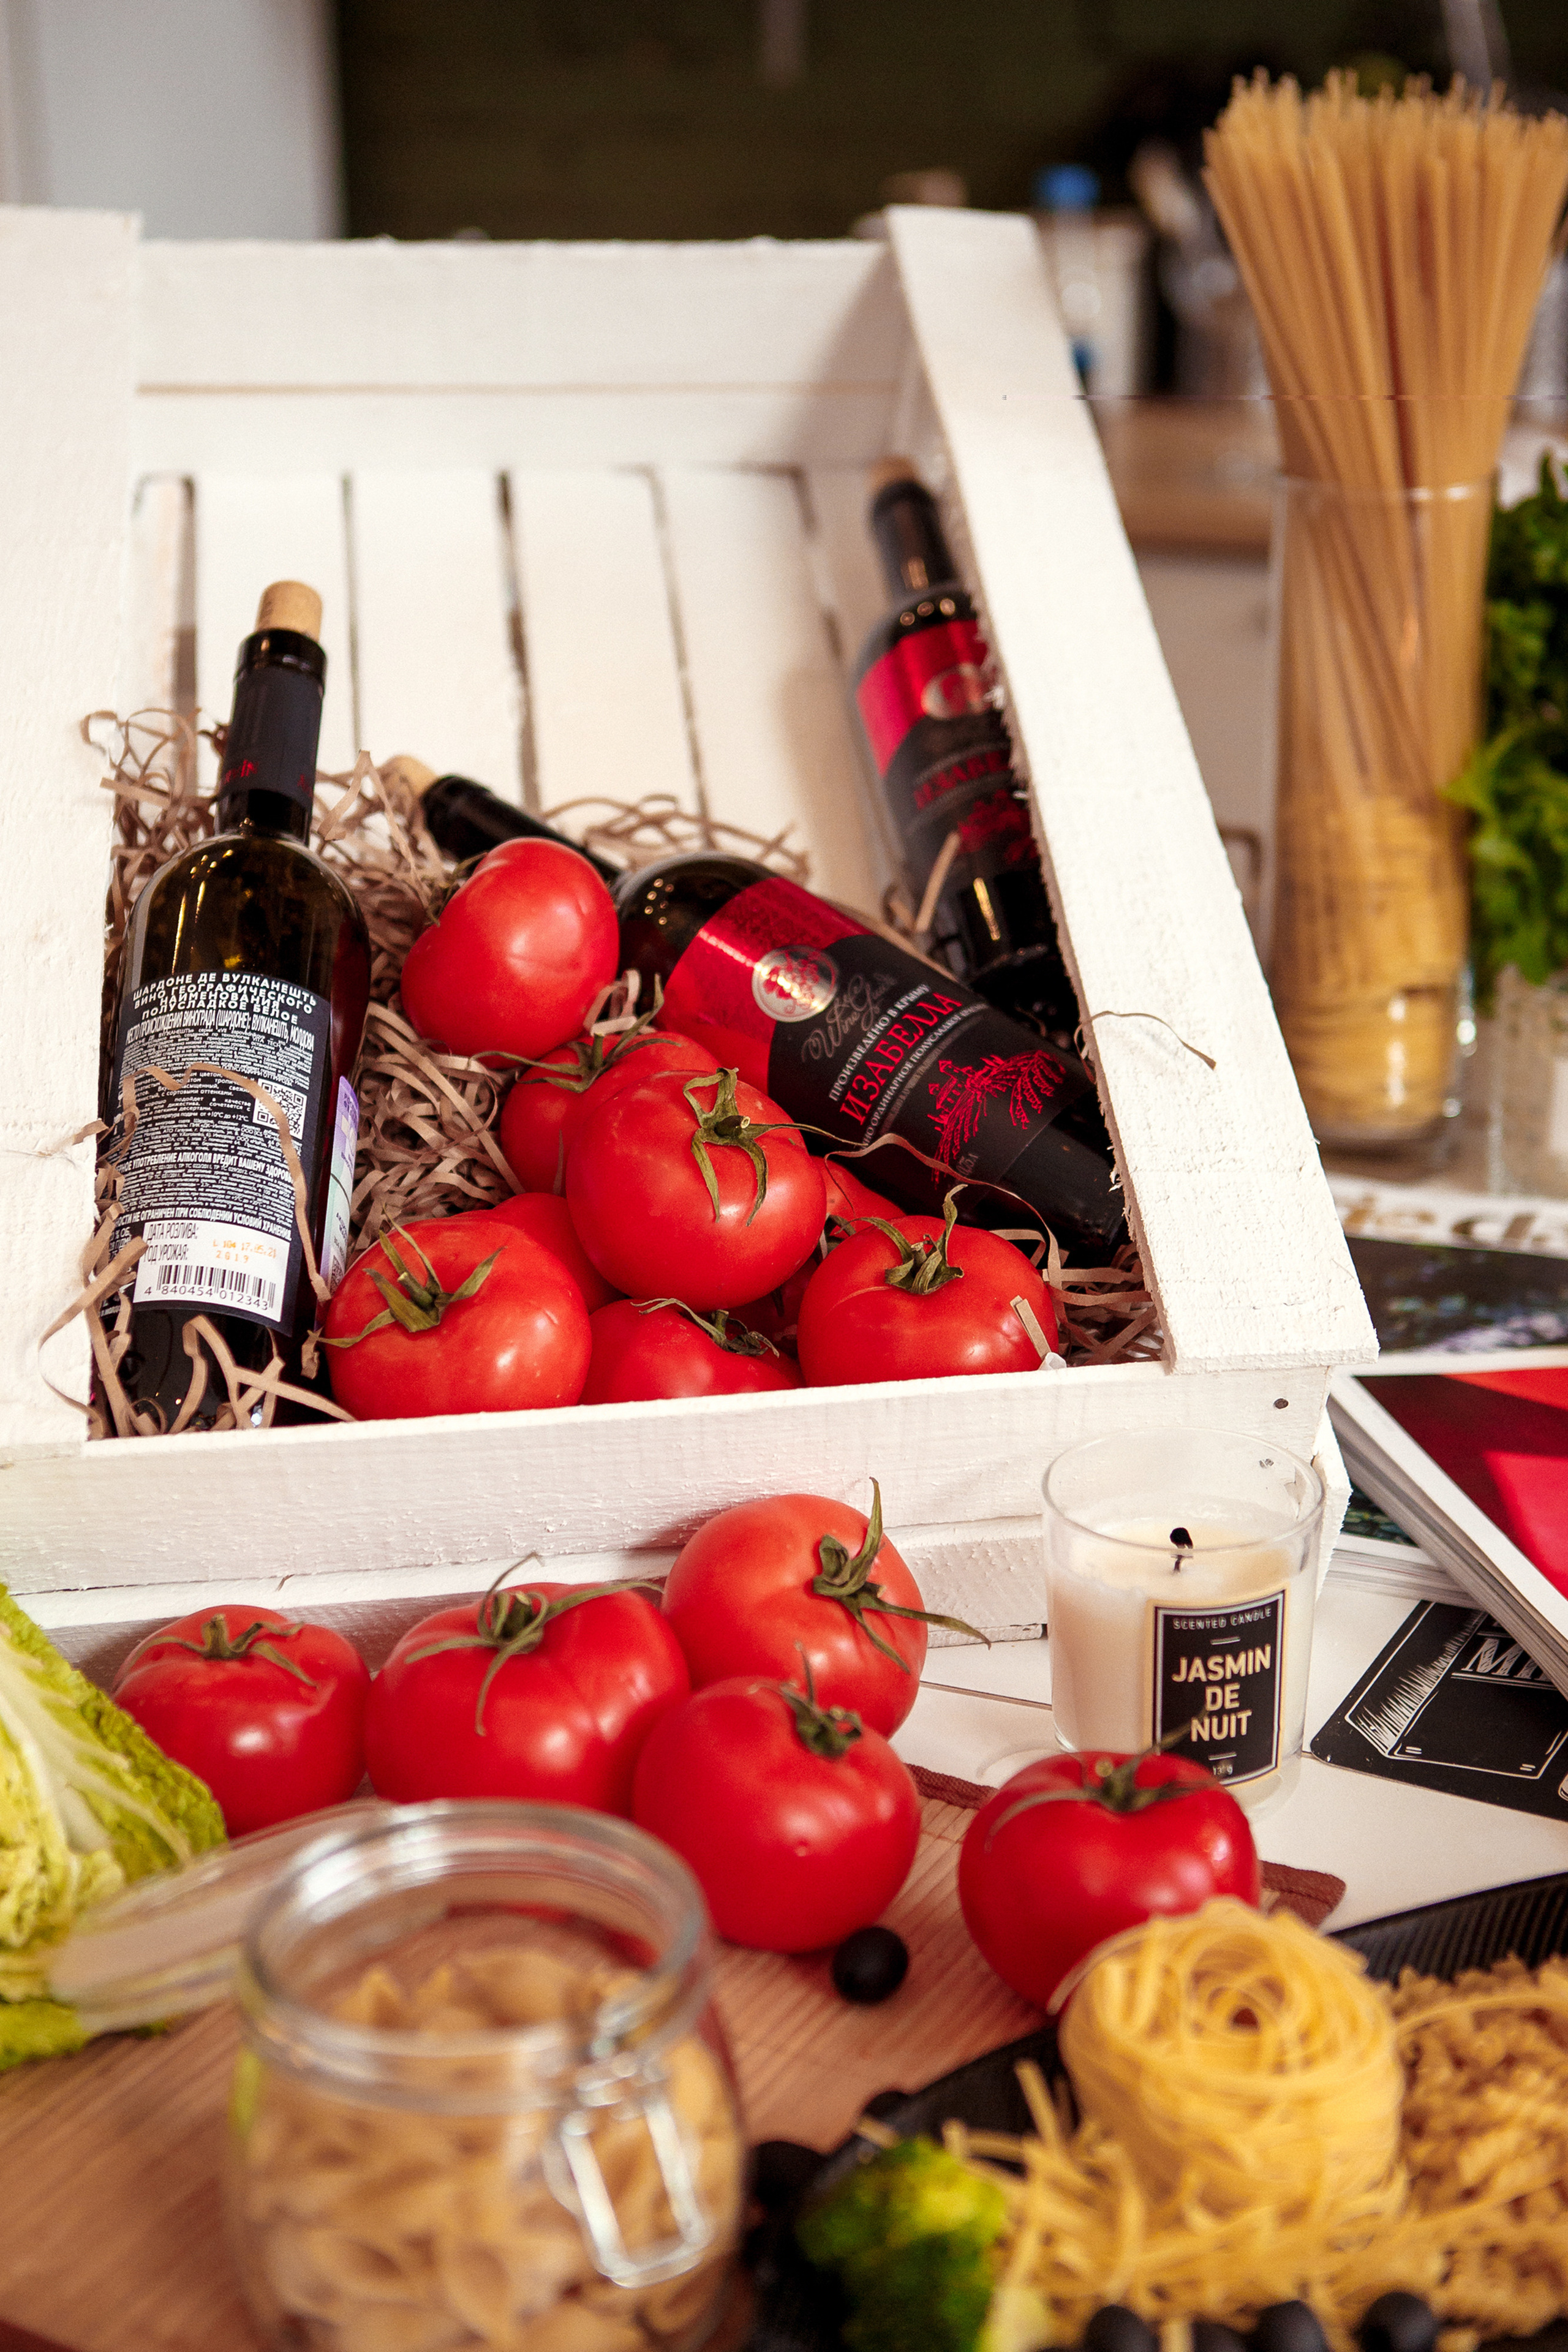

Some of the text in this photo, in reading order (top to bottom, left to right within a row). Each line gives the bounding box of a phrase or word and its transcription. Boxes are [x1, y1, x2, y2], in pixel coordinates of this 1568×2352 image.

[133, 971, 317, 1008] ШАРДОНЕ ДЕ ВУЛКАНЕШТЬ
[134, 981, 312, 1016] ВИНО ГЕОГРАФИЧЕСКОГО
[159, 989, 279, 1011] НАИМЕНОВАНИЯ
[141, 997, 298, 1025] ПОЛУСЛАДКОЕ БЕЛОЕ
[182, 1008, 216, 1030] ВИНОГРАДА
[828, 1017, 889, 1101] ПРОИЗВЕДЕНО
[886, 1008, 898, 1016] В
[839, 993, 962, 1125] ИЗАБЕЛЛА
[871, 1060, 913, 1126] ОРДИНАРНОЕ
[177, 1152, 212, 1163] АЛКОГОЛЯ
[212, 1153, 238, 1168] ВРЕДИТ
[238, 1156, 265, 1174] ВАШЕМУ
[132, 1212, 140, 1222] НЕ
[140, 1208, 175, 1221] ОГРАНИЧЕН
[175, 1207, 189, 1217] ПРИ
[233, 1210, 262, 1229] УСЛОВИЙ
[147, 1222, 198, 1243] ДАТА РОЗЛИВА:
[158, 1244, 189, 1262] УРОЖАЯ:
[144, 1284, 270, 1311] 4 840454 012343
[1172, 1607, 1272, 1630] SCENTED CANDLE
[1172, 1643, 1271, 1683] JASMIN
[1205, 1682, 1240, 1711] DE
[1190, 1709, 1253, 1743] NUIT
